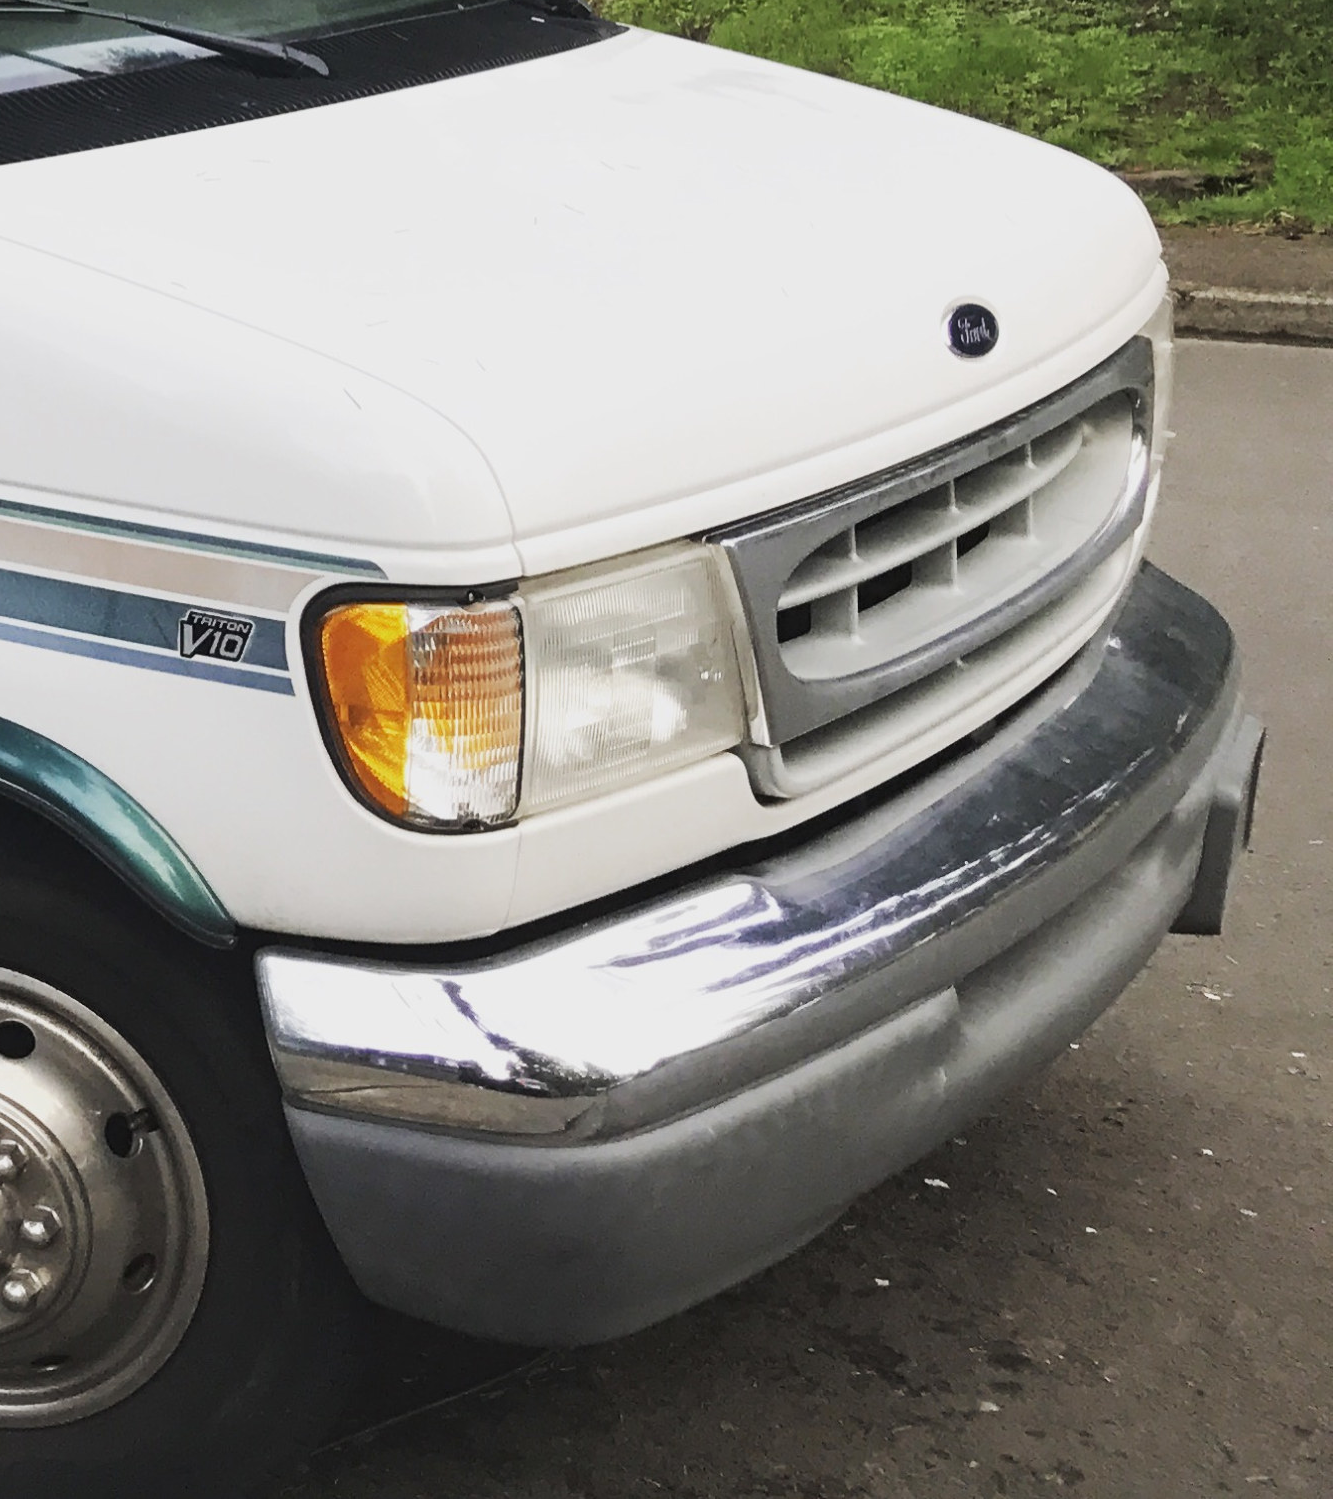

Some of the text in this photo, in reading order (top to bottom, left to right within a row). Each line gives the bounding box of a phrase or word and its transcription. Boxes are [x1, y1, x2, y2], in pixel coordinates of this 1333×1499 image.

[957, 316, 990, 345] Ford
[191, 614, 250, 633] TRITON
[182, 623, 244, 659] V10
